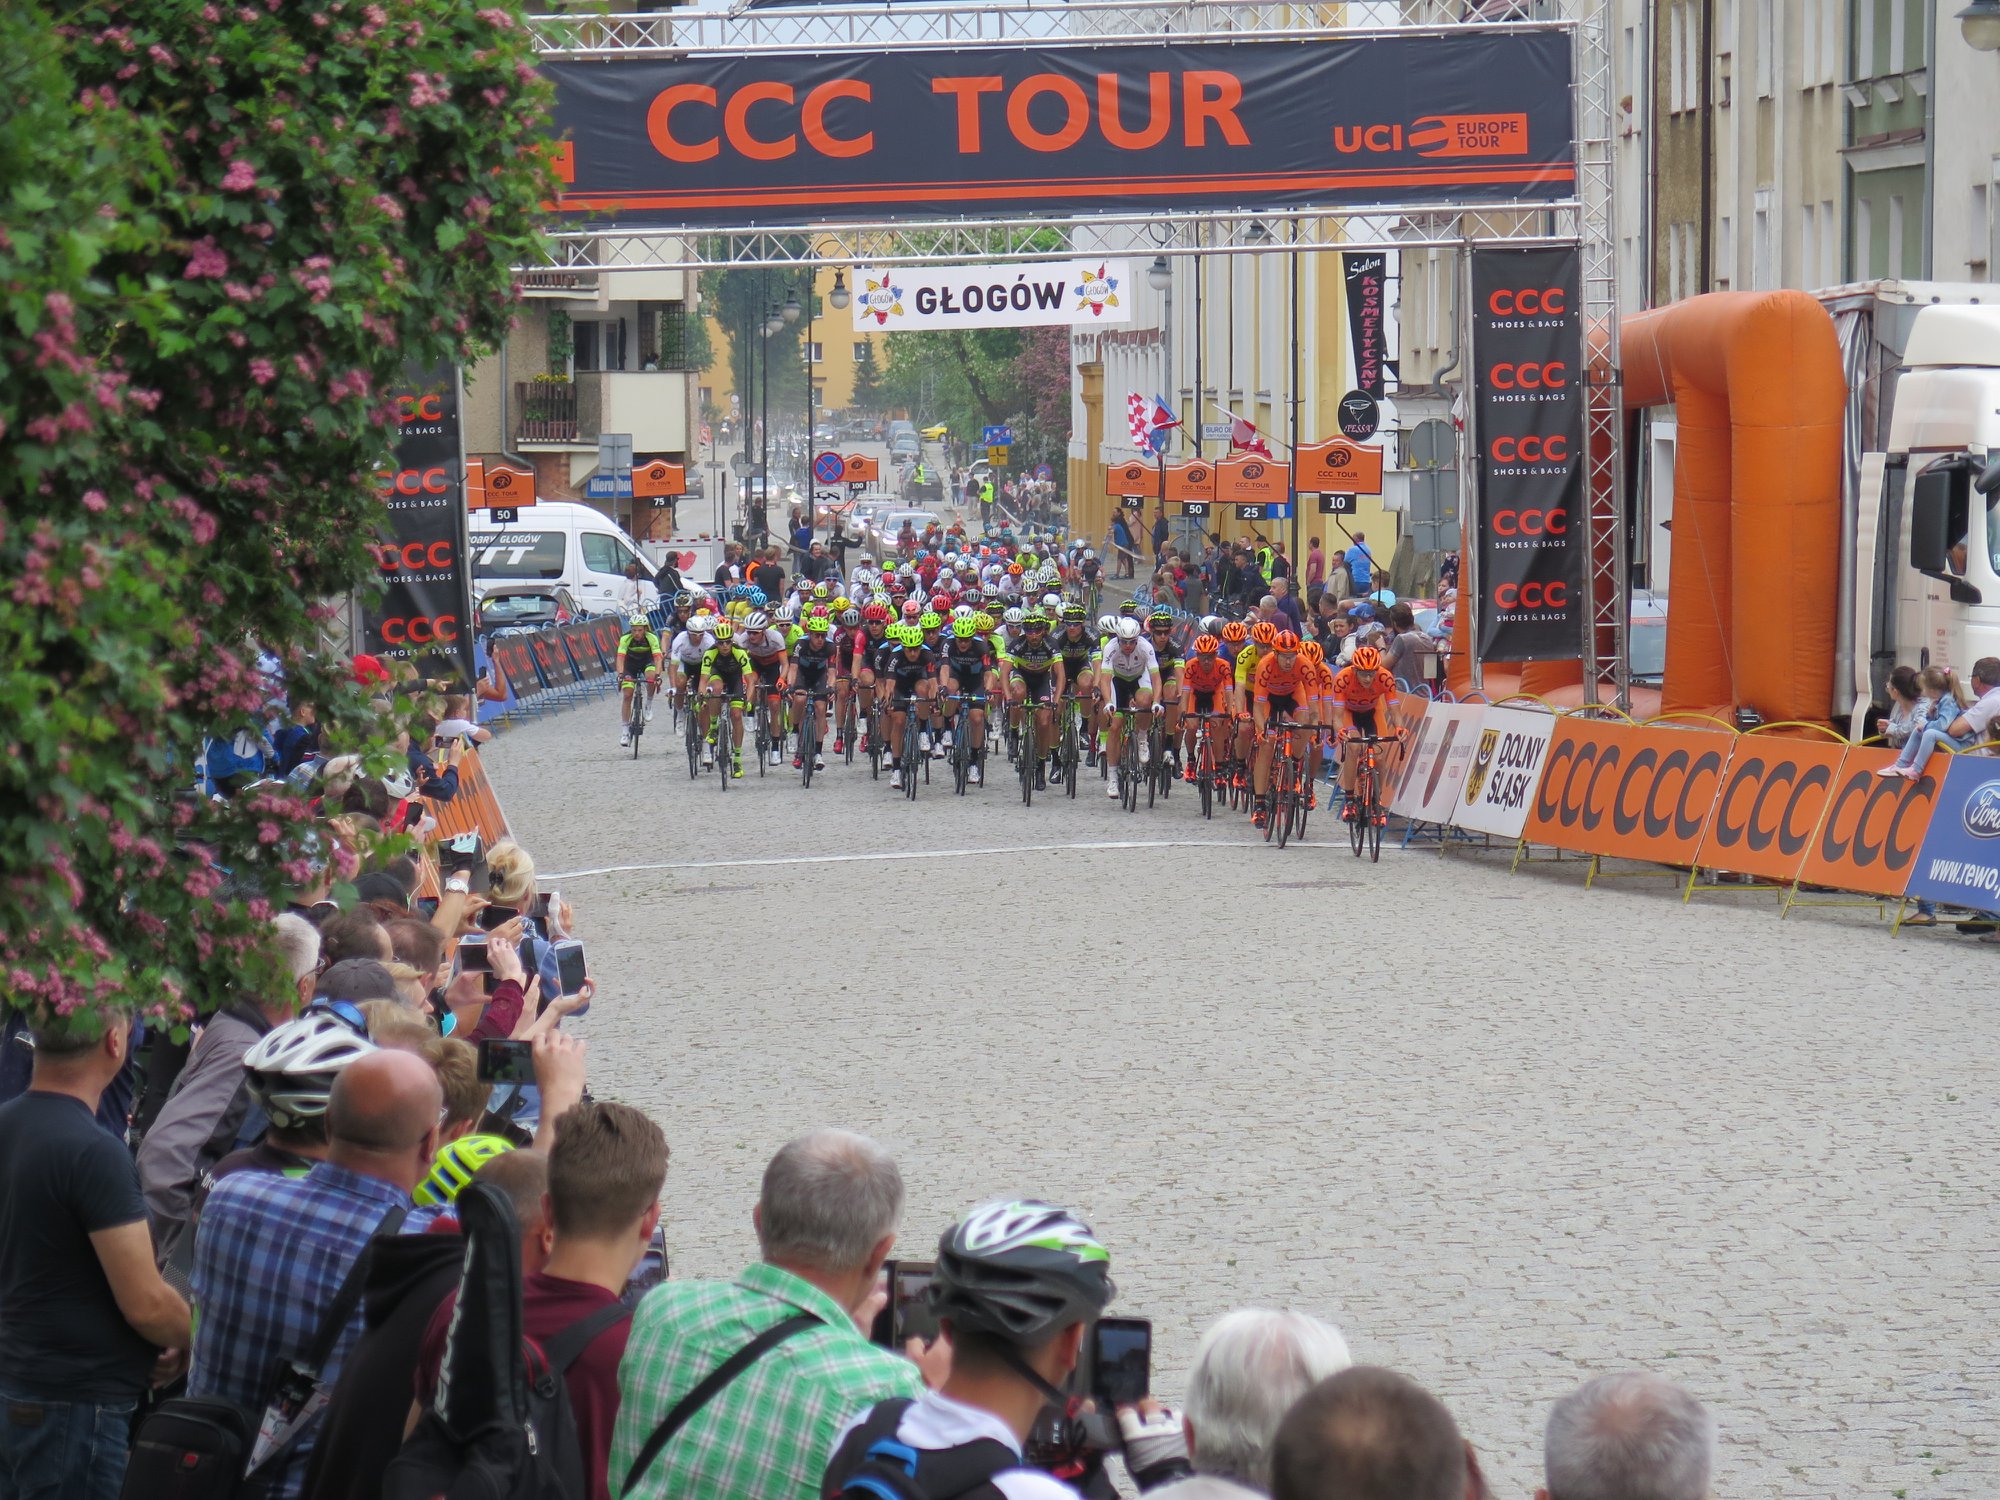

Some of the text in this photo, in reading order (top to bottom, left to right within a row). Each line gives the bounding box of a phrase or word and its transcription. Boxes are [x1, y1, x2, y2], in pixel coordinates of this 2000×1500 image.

[646, 70, 1252, 163] CCC TOUR
[1457, 121, 1519, 135] EUROPE
[1333, 124, 1402, 153] UCI
[1458, 135, 1500, 149] TOUR
[1346, 257, 1381, 280] Salon
[915, 273, 1066, 315] GŁOGÓW
[1489, 288, 1565, 316] CCC
[1360, 276, 1380, 390] KOSMETYCZNY
[1491, 321, 1525, 329] SHOES
[1538, 320, 1565, 328] BAGS
[1490, 362, 1566, 390] CCC
[1492, 394, 1526, 402] SHOES
[1539, 393, 1566, 401] BAGS
[415, 426, 443, 434] BAGS
[1491, 435, 1567, 463] CCC
[1493, 468, 1527, 476] SHOES
[1540, 467, 1567, 475] BAGS
[420, 499, 448, 507] BAGS
[654, 498, 665, 506] 75
[1127, 497, 1138, 506] 75
[1189, 505, 1202, 514] 50
[1329, 497, 1346, 509] 10
[497, 510, 510, 520] 50
[1243, 507, 1258, 518] 25
[1492, 508, 1567, 536] CCC
[469, 535, 496, 544] OBRY
[1495, 542, 1529, 550] SHOES
[1542, 540, 1566, 548] BAGS
[469, 545, 535, 565] TT
[385, 575, 412, 583] HOES
[425, 573, 452, 582] BAGS
[1494, 581, 1567, 608] CCC
[1496, 614, 1529, 622] SHOES
[1542, 613, 1567, 621] BAGS
[381, 615, 457, 644] CCC
[1497, 732, 1546, 771] DOLNY
[1486, 764, 1532, 812] ŚLĄSK
[1537, 738, 1621, 831] CCC
[1612, 748, 1722, 840] CCC
[1716, 757, 1832, 856] CCC
[1821, 769, 1937, 871] CCC
